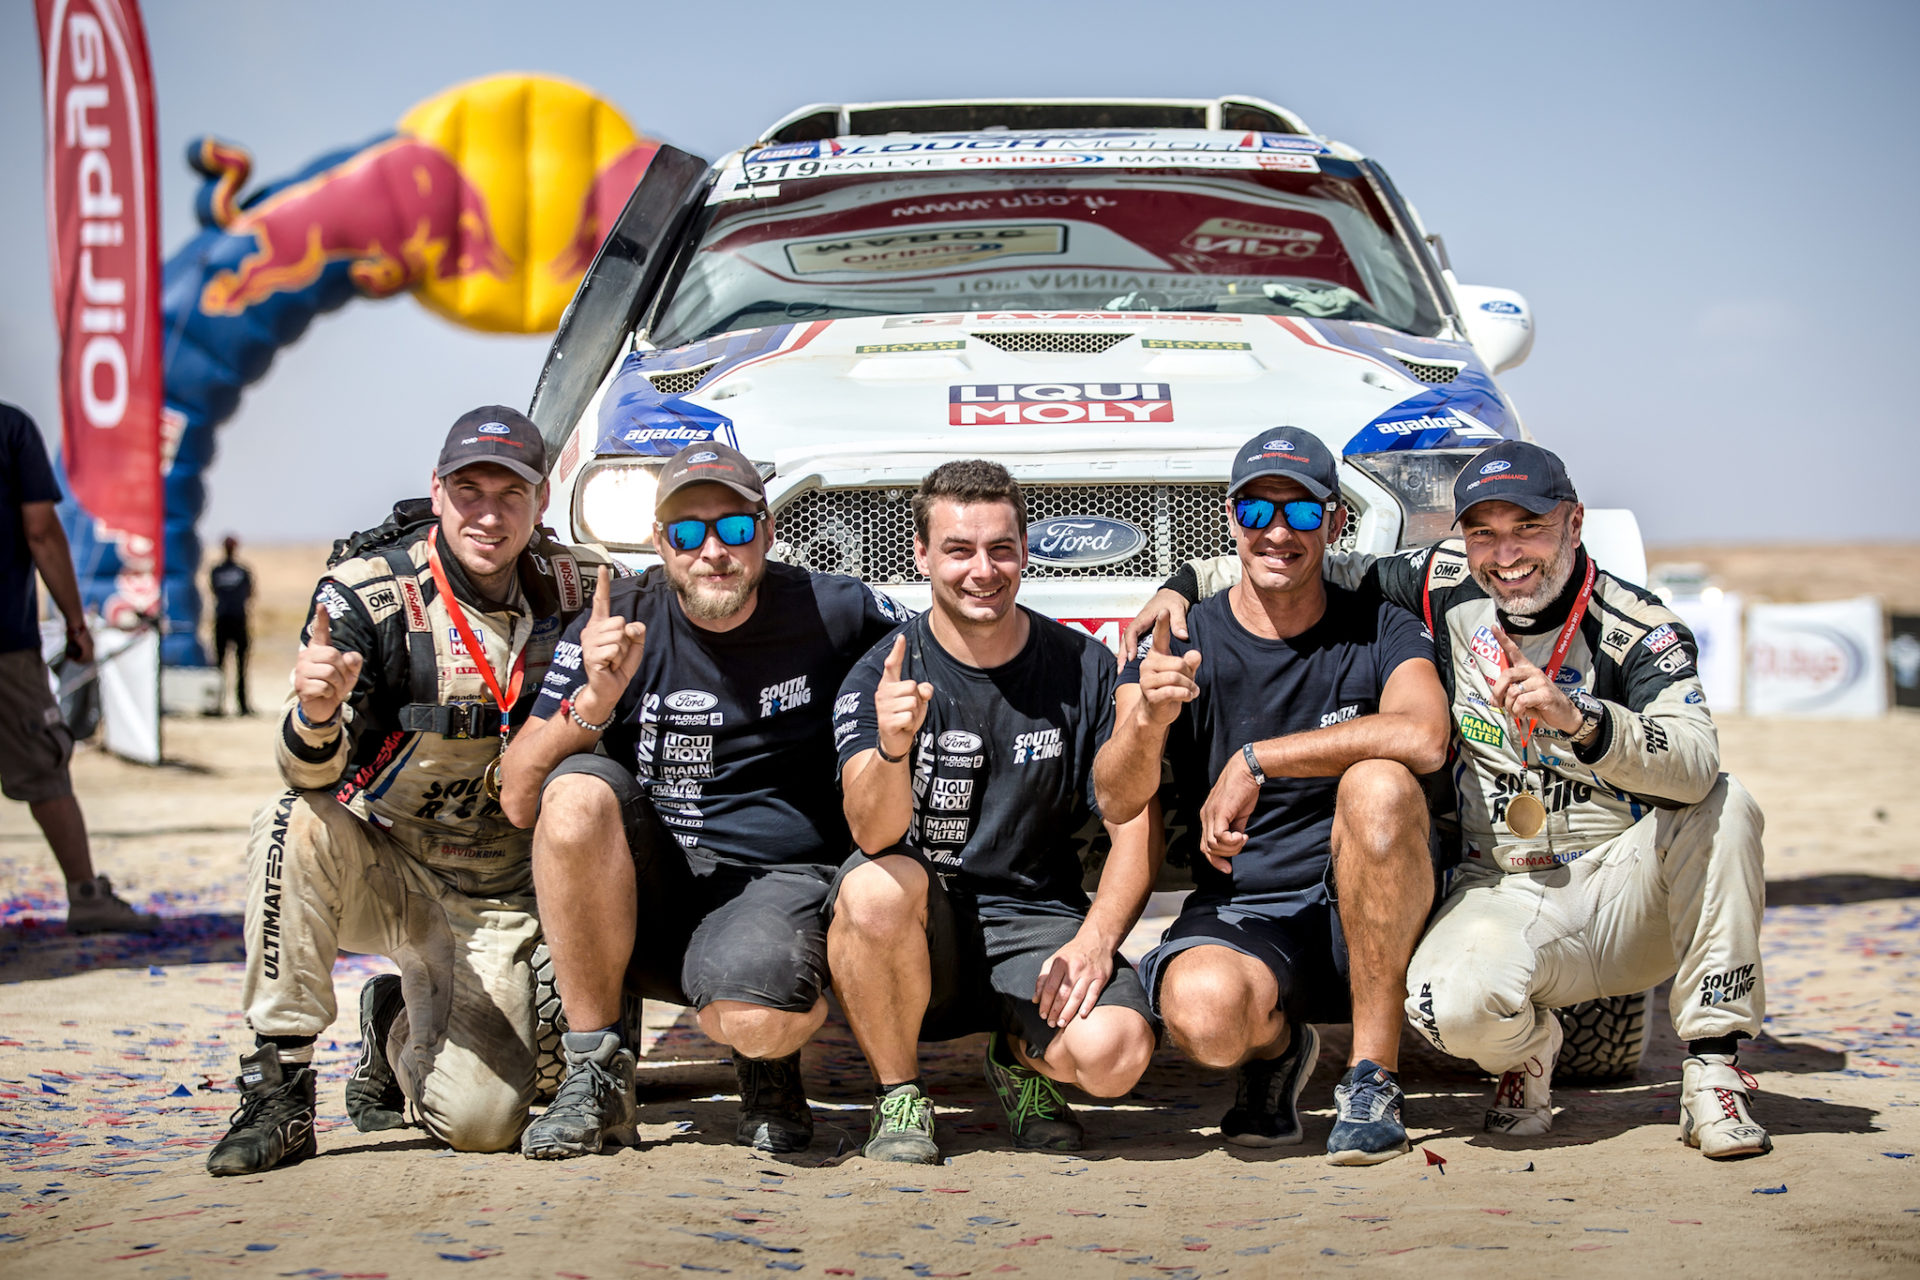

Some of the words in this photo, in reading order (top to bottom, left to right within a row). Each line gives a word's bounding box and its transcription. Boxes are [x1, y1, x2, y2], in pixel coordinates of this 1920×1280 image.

[747, 161, 820, 180] 319
[824, 158, 942, 171] RALLYE
[960, 156, 1078, 164] OiLibya
[1119, 155, 1241, 164] MAROC
[961, 384, 1160, 401] LIQUI
[960, 402, 1169, 424] MOLY
[624, 425, 711, 444] agados
[1374, 415, 1463, 436] agados
[1040, 522, 1114, 552] Ford
[1434, 564, 1461, 577] OMP
[558, 560, 577, 607] SIMPSON
[369, 590, 395, 607] OMP
[404, 582, 425, 628] SIMPSON
[1606, 631, 1631, 647] OMP
[1643, 624, 1673, 645] LIQUI
[1650, 634, 1678, 653] MOLY
[1659, 649, 1688, 672] OMP
[759, 675, 807, 702] SOUTH
[675, 693, 706, 707] Ford
[1319, 704, 1358, 728] SOUTH
[1461, 726, 1500, 746] FILTER
[1462, 716, 1501, 737] MANN
[668, 733, 710, 748] LIQUI
[944, 734, 971, 749] Ford
[1013, 728, 1062, 750] SOUTH
[665, 747, 711, 760] MOLY
[1539, 753, 1576, 768] XTline
[663, 763, 710, 775] MANN
[944, 761, 972, 769] MOTORS
[935, 780, 971, 795] LIQUI
[931, 795, 970, 809] MOLY
[926, 819, 967, 831] MANN
[926, 829, 965, 841] FILTER
[922, 847, 963, 867] XTline
[1700, 964, 1755, 991] SOUTH
